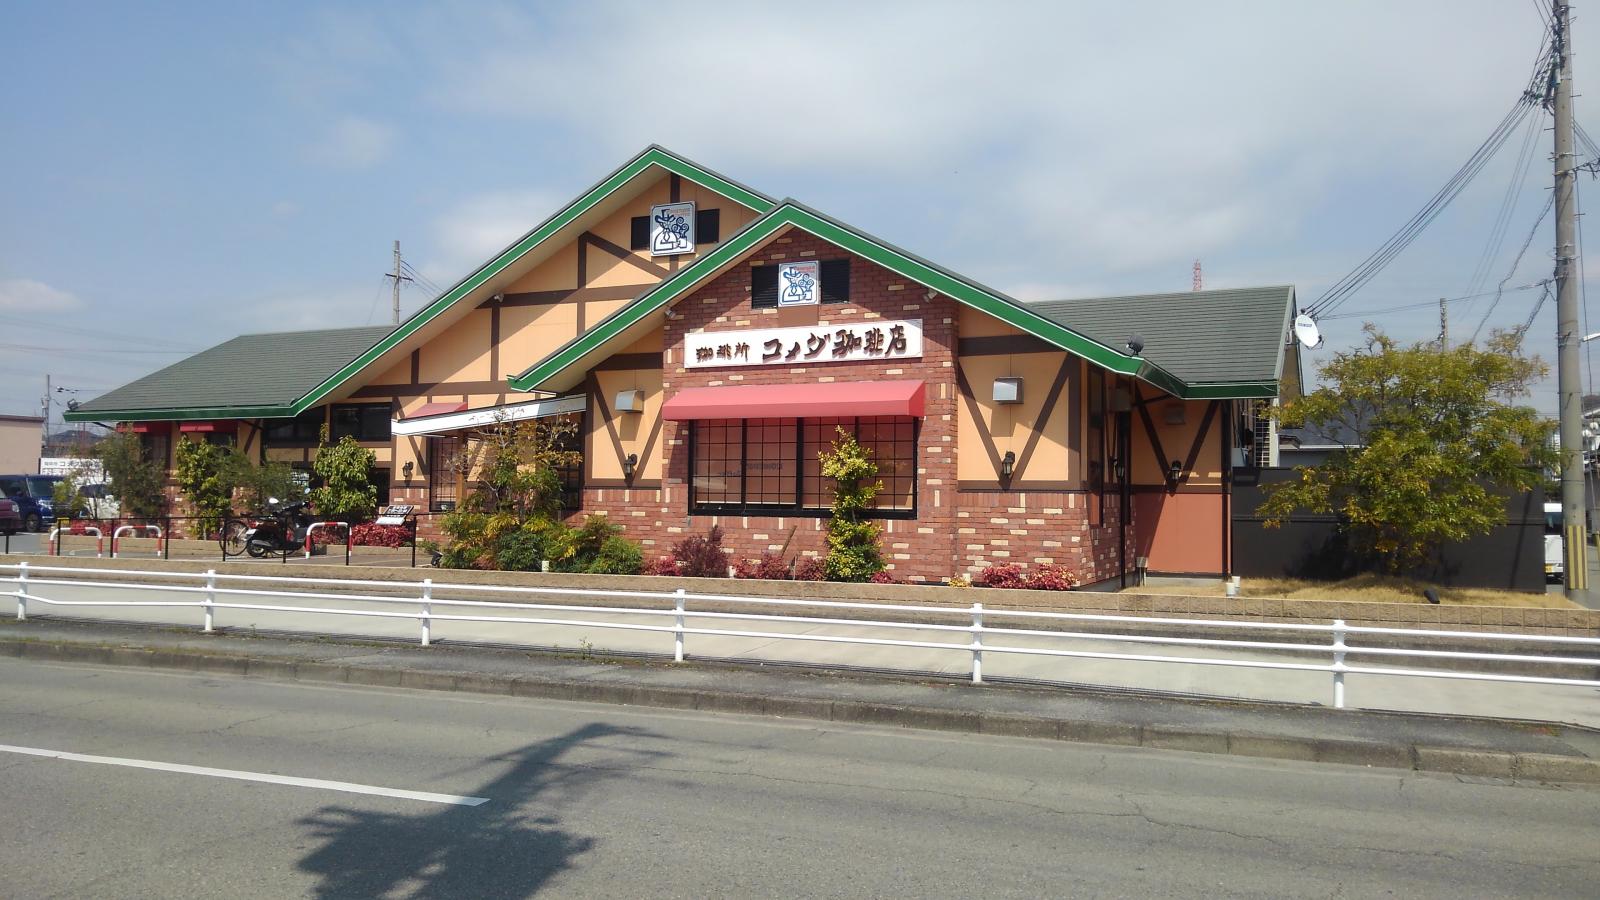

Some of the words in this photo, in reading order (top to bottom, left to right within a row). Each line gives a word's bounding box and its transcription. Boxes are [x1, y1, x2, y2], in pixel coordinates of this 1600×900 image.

[762, 324, 907, 358] コメダ珈琲店
